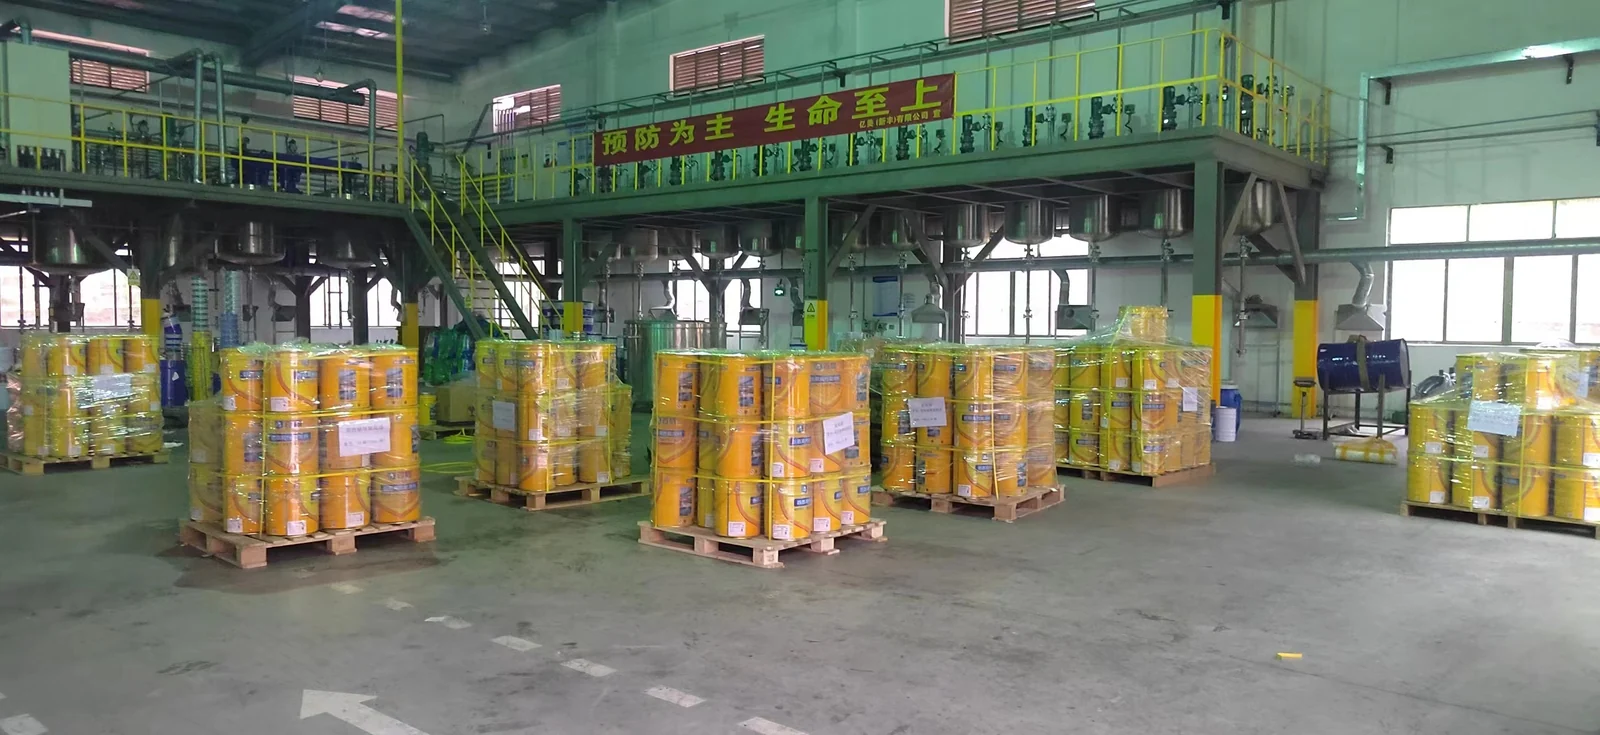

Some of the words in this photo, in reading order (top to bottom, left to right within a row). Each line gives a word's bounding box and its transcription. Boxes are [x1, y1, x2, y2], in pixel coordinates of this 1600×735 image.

[601, 113, 735, 156] 预防为主
[763, 79, 942, 133] 生命至上
